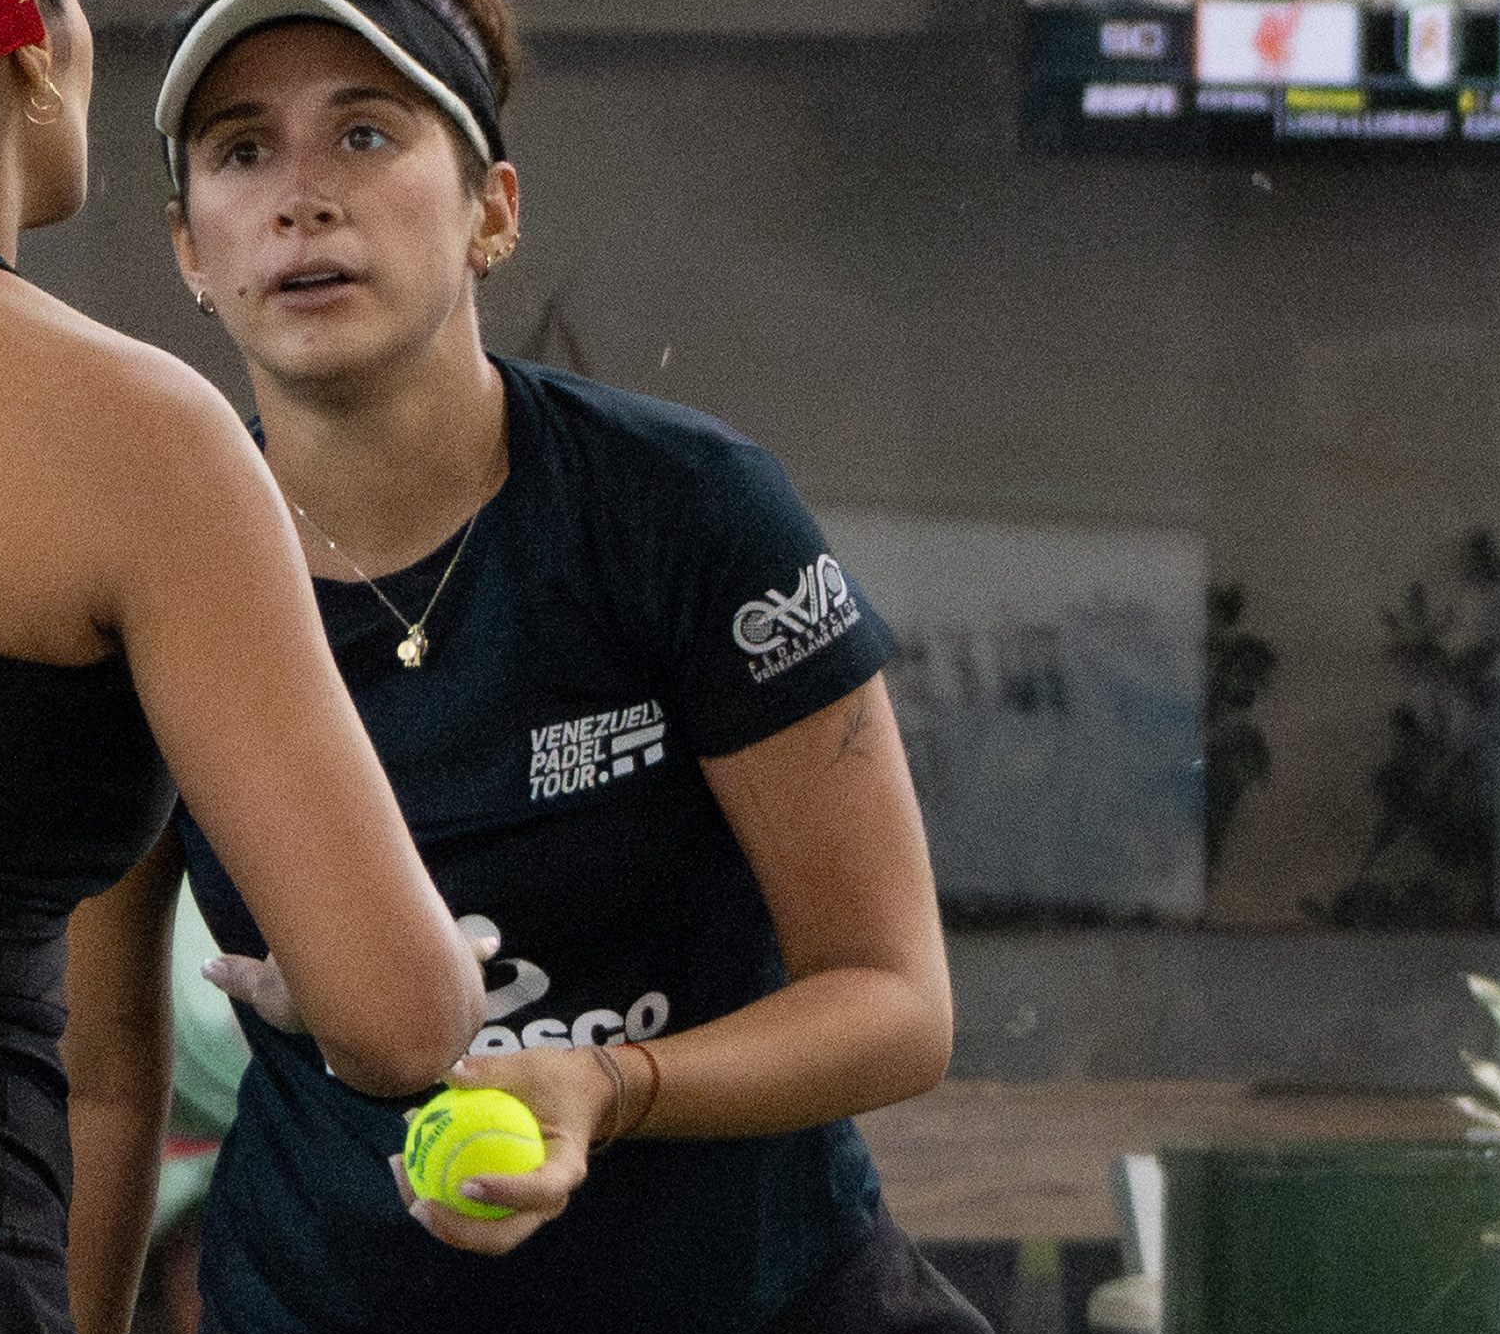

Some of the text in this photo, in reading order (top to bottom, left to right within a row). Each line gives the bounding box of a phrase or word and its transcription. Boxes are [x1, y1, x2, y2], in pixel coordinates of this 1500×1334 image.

[530, 699, 665, 752] VENEZUELA
[529, 737, 608, 777] PADEL
[468, 990, 670, 1056] esco
